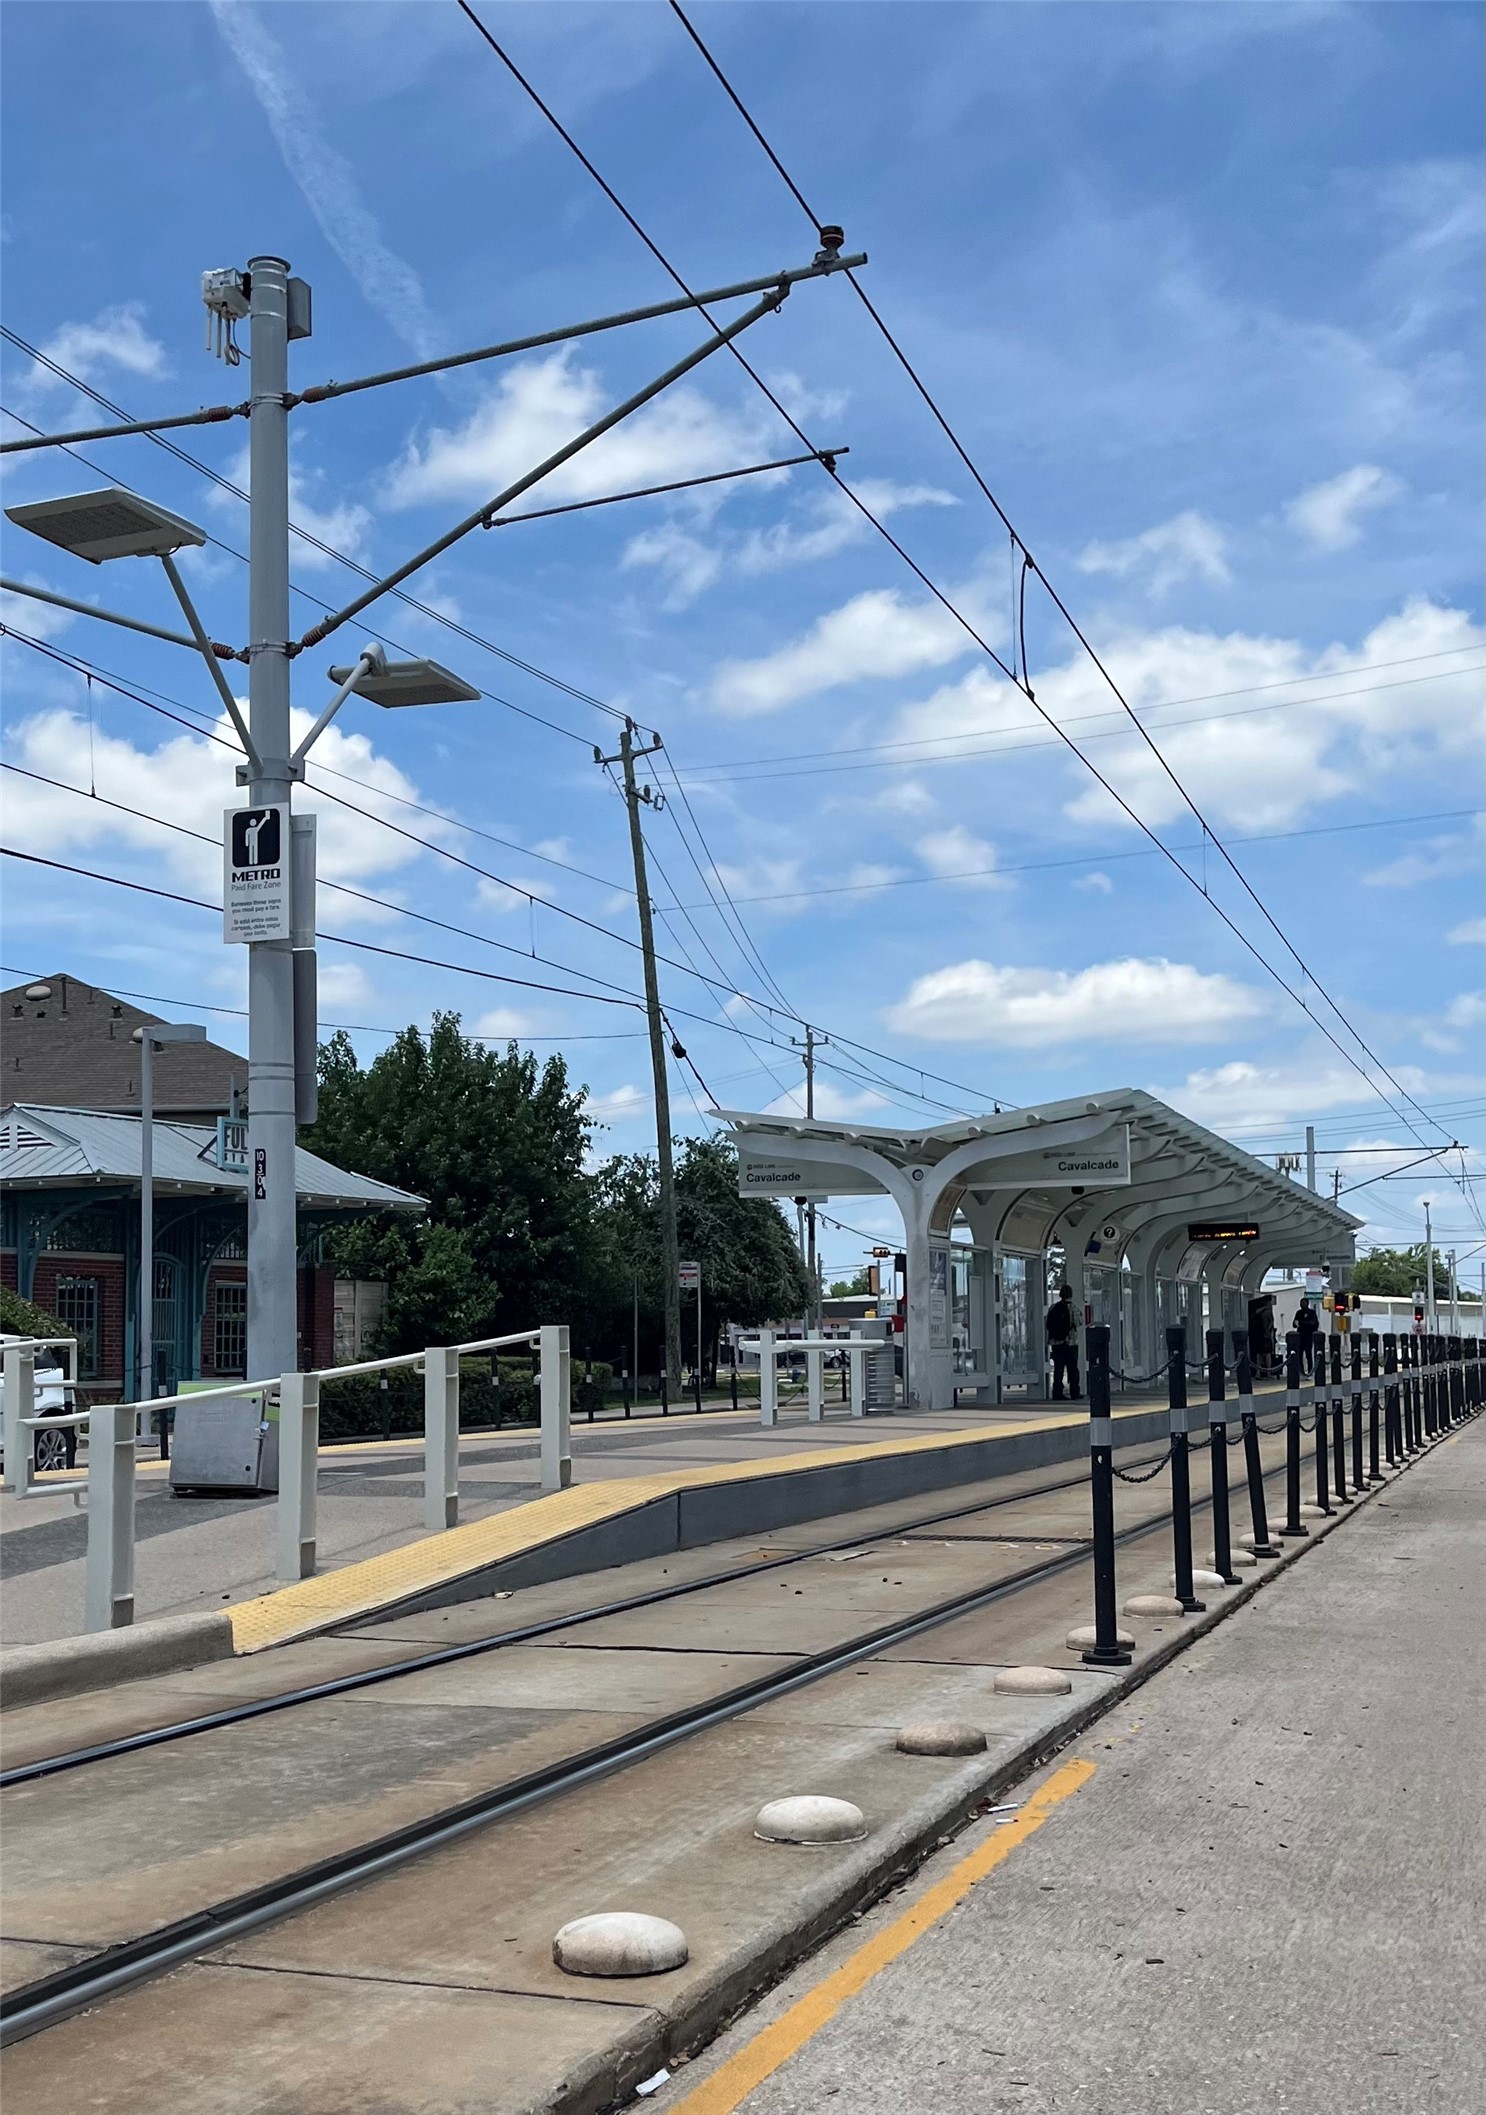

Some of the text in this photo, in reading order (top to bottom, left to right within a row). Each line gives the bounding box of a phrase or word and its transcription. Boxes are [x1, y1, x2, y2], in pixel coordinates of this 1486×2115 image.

[232, 868, 281, 883] METRO
[247, 882, 262, 890] Fare
[263, 881, 281, 889] Zone
[224, 1125, 249, 1150] FUL
[1058, 1160, 1119, 1171] Cavalcade
[746, 1172, 801, 1182] Cavalcade
[257, 1187, 263, 1197] 4
